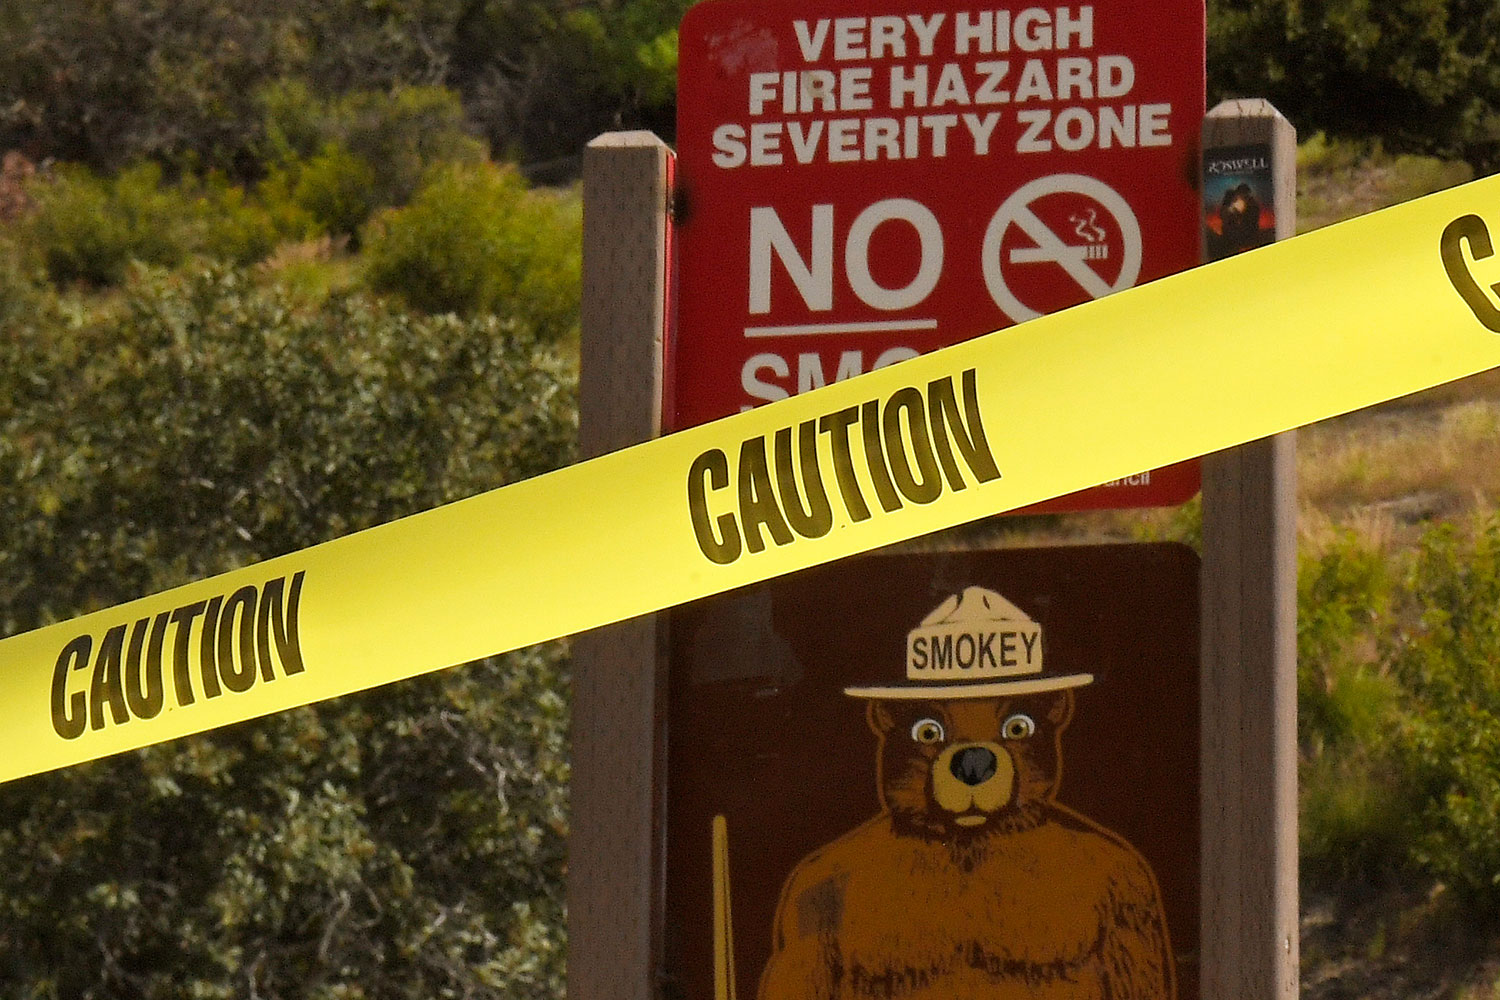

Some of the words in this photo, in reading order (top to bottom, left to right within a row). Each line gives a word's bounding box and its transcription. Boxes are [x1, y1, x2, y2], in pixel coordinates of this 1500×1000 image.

[793, 13, 945, 62] VERY
[955, 5, 1095, 55] HIGH
[748, 68, 873, 115] FIRE
[889, 55, 1136, 108] HAZARD
[711, 111, 1000, 169] SEVERITY
[1015, 103, 1173, 154] ZONE
[748, 197, 944, 315] NO
[688, 367, 1002, 566] CAUTION
[51, 570, 306, 741] CAUTION
[912, 631, 1038, 670] SMOKEY
